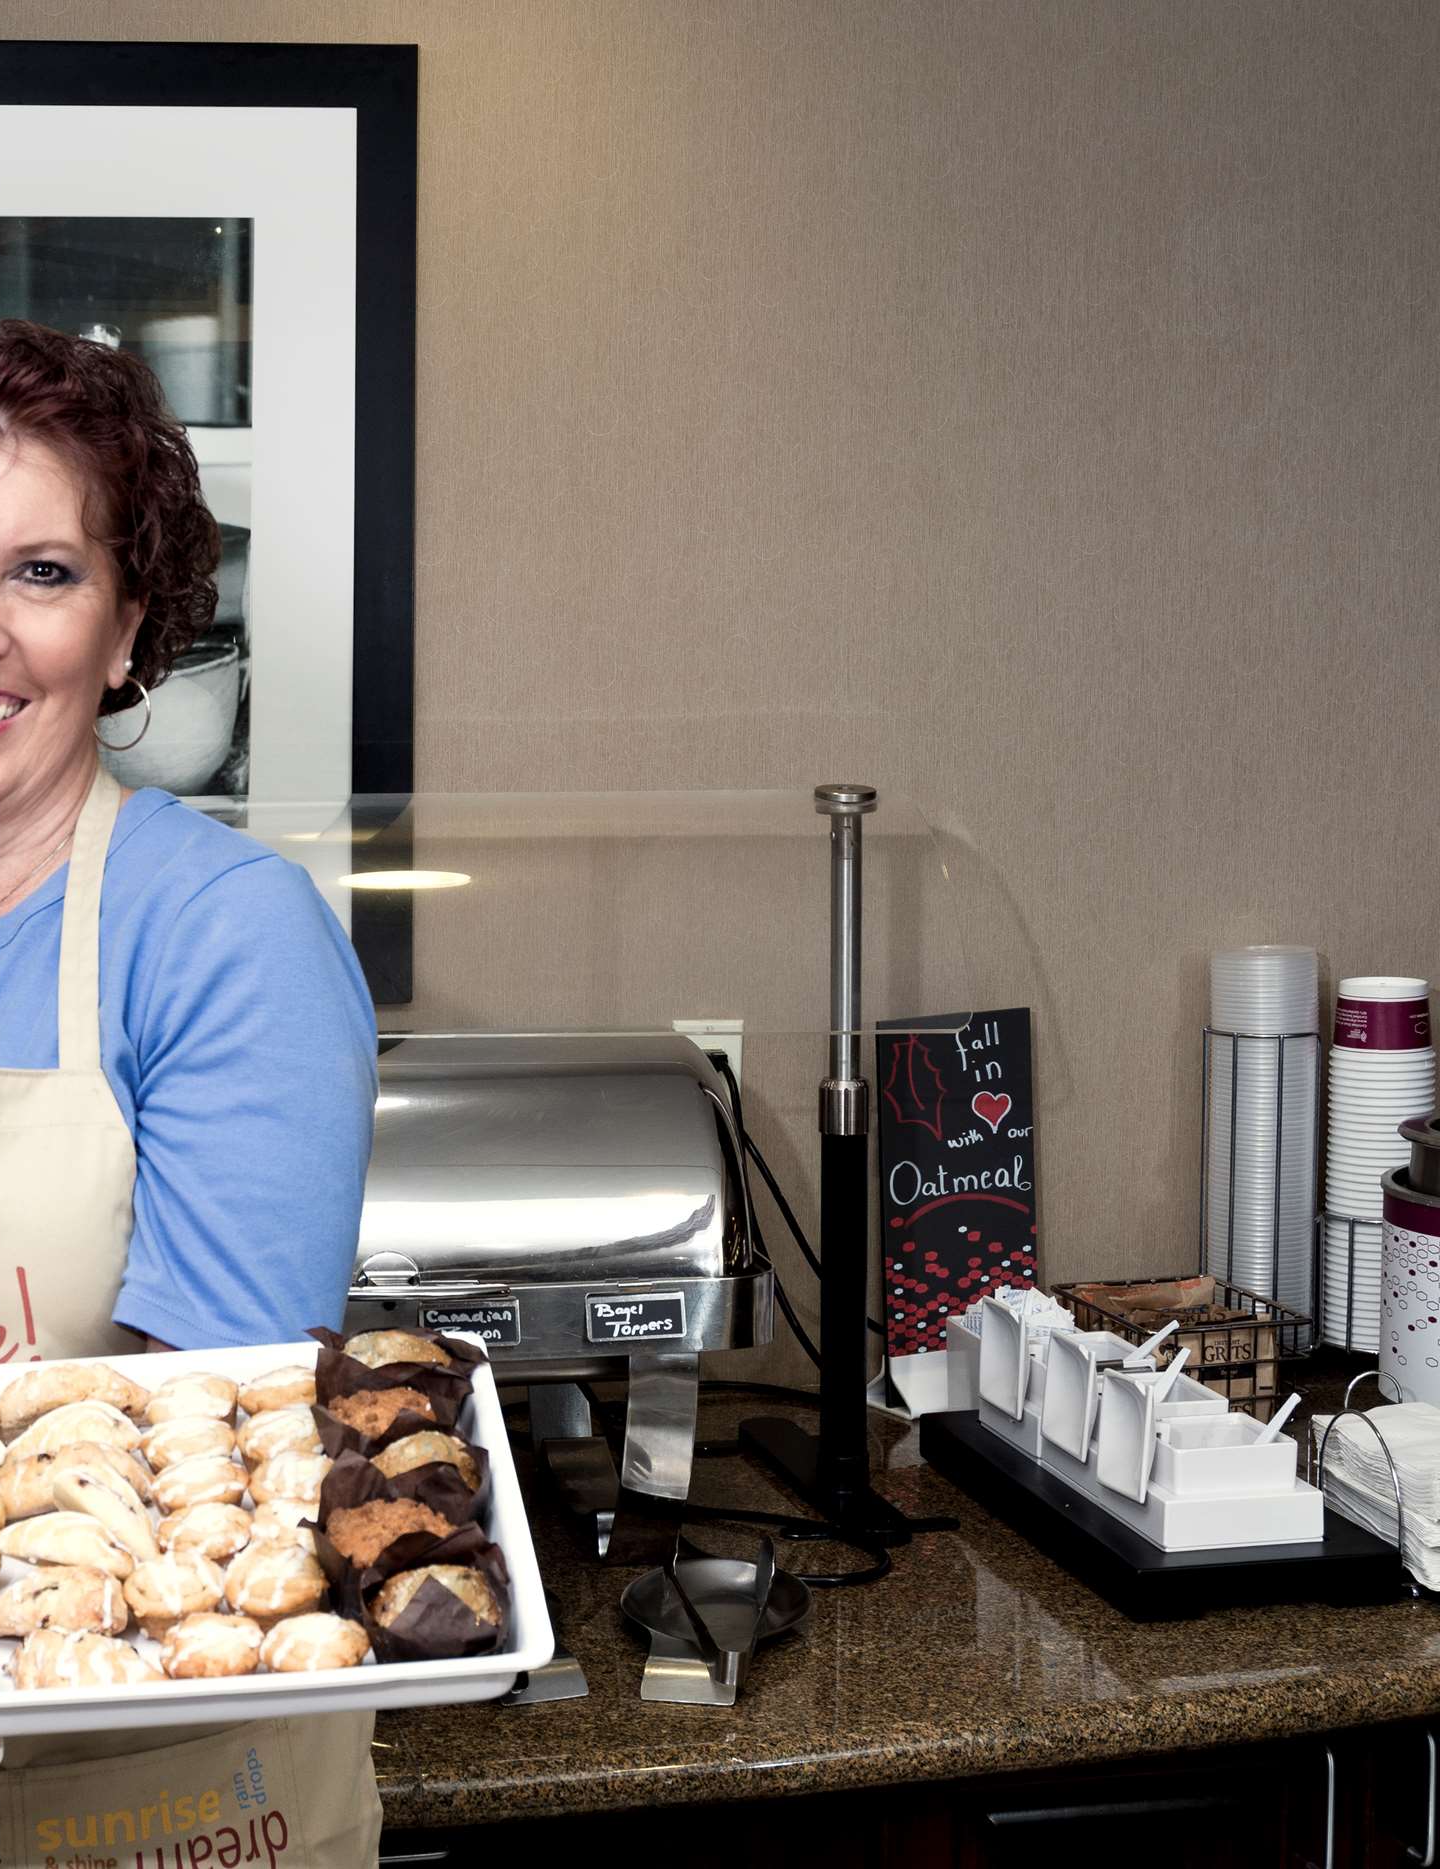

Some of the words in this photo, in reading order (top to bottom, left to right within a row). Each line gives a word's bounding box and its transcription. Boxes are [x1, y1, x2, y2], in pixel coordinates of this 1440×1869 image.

[971, 1060, 1003, 1083] in
[947, 1129, 984, 1149] with
[1008, 1126, 1034, 1139] our
[889, 1154, 1032, 1206] Oatmeal
[425, 1310, 512, 1324] Canadian
[594, 1302, 644, 1322] Bagel
[604, 1318, 673, 1338] Toppers
[1203, 1343, 1252, 1362] GRTS
[246, 1747, 268, 1806] drops
[232, 1772, 252, 1811] rain
[35, 1789, 222, 1852] sunrise
